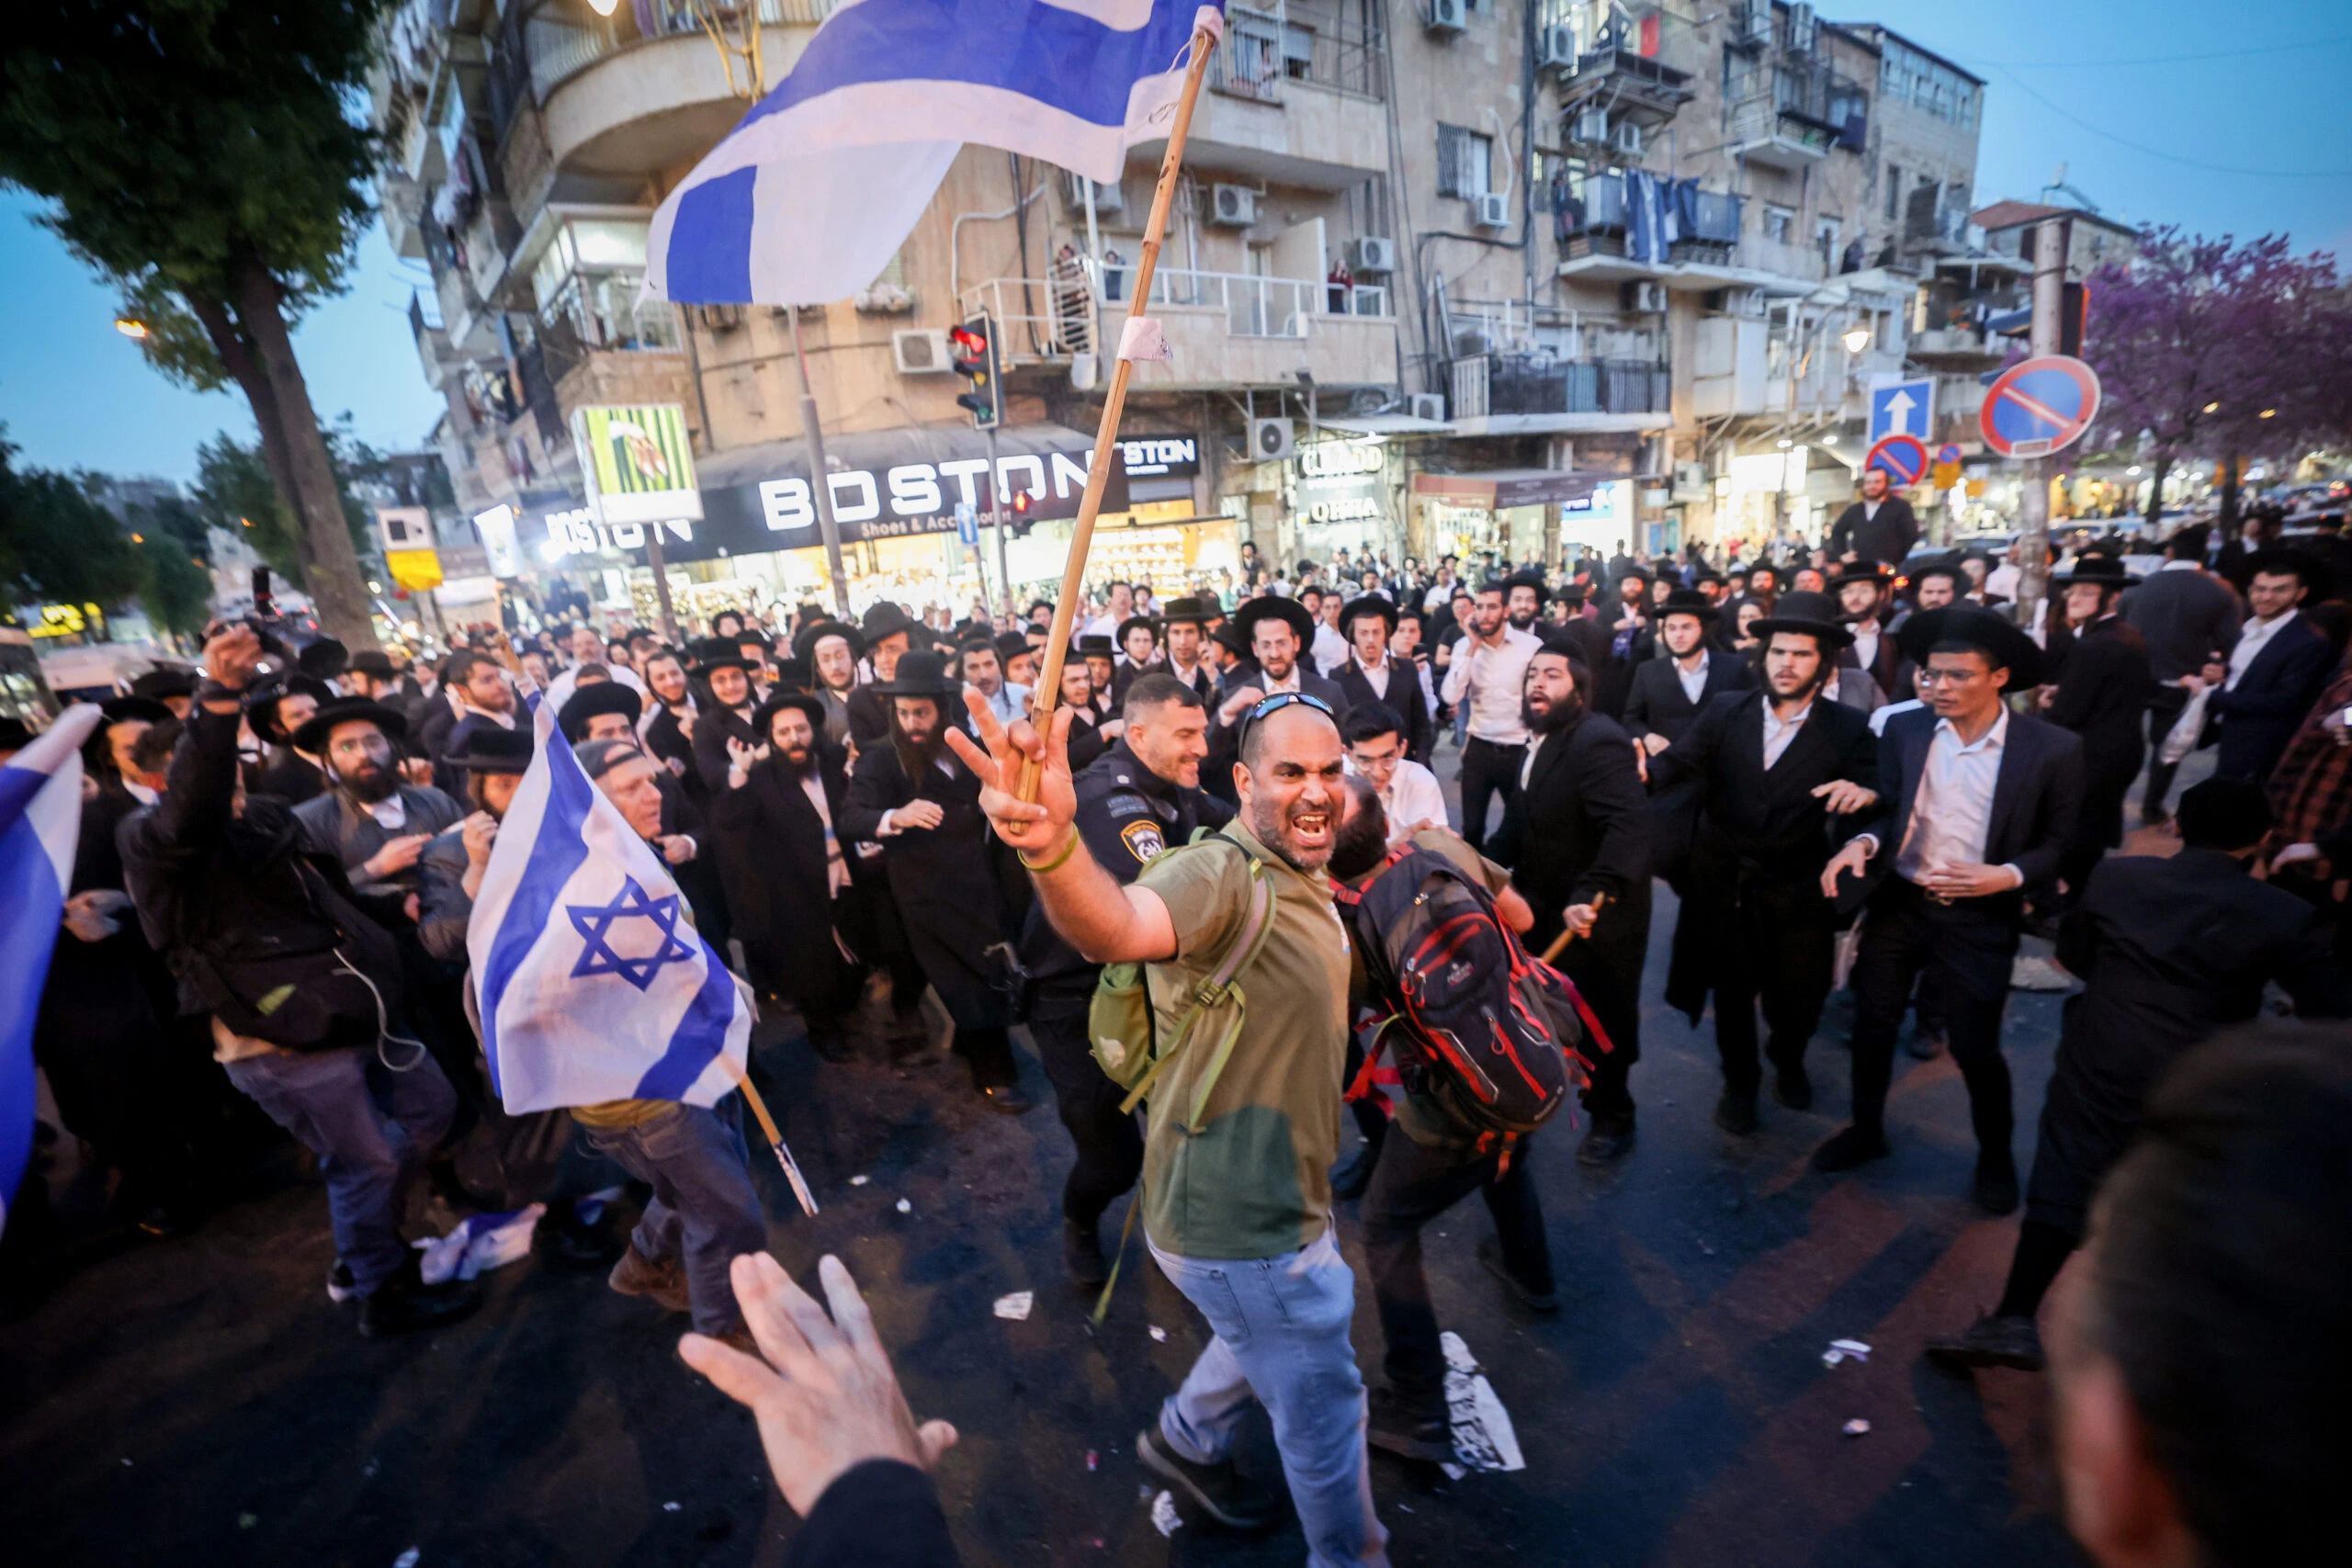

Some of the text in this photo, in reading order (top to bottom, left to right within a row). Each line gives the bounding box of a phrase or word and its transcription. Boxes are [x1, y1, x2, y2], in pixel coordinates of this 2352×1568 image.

[759, 450, 1095, 531] BOSTON
[861, 520, 908, 537] Shoes
[910, 516, 922, 533] &
